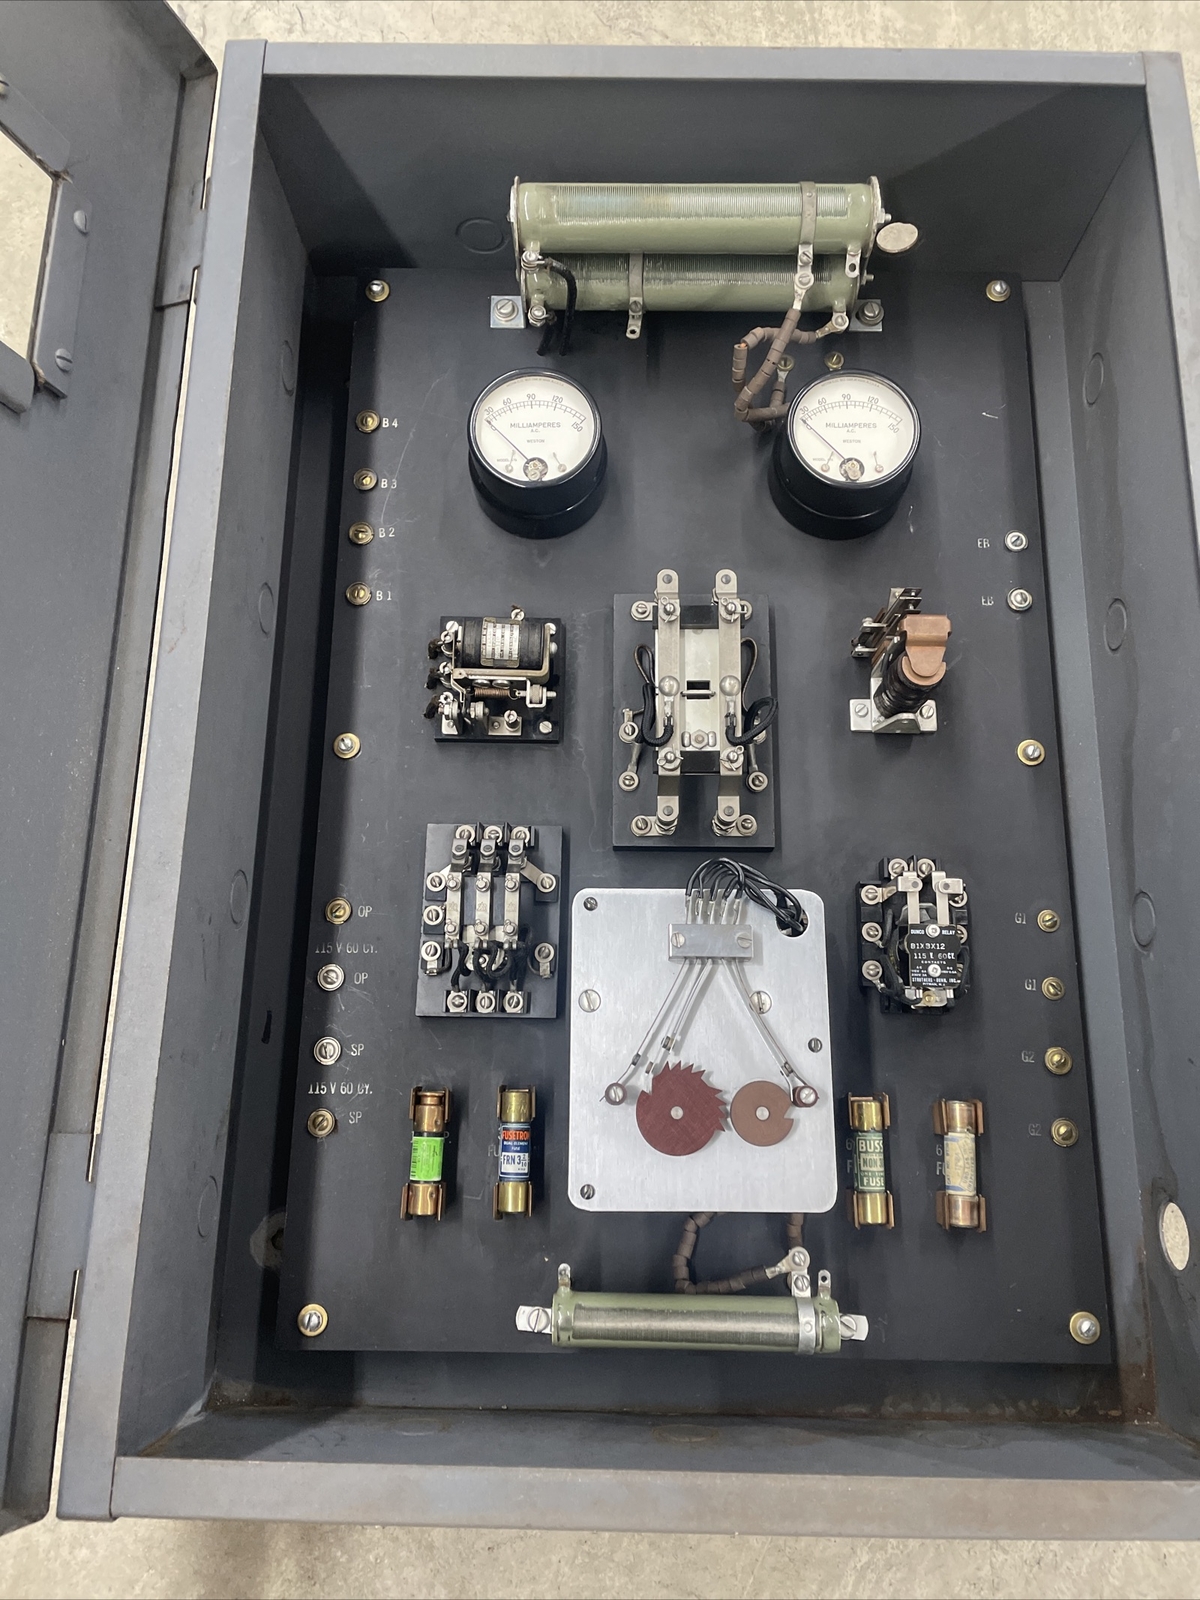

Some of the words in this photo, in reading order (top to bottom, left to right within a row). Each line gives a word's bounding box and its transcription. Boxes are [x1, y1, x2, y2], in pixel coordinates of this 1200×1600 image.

[503, 398, 512, 406] 60
[552, 395, 563, 403] 120
[868, 396, 879, 404] 120
[484, 407, 494, 415] 30
[799, 406, 809, 415] 30
[571, 422, 583, 432] 150
[888, 423, 899, 434] 150
[358, 906, 372, 917] OP
[315, 942, 332, 953] 115
[336, 942, 342, 953] V
[347, 942, 358, 953] 60
[354, 972, 368, 984] OP
[351, 1043, 364, 1056] SP
[1022, 1050, 1034, 1062] G2
[308, 1082, 327, 1094] 115
[330, 1082, 336, 1094] V
[340, 1082, 353, 1094] 60
[358, 1083, 372, 1094] CY.
[349, 1111, 362, 1124] SP
[1028, 1124, 1041, 1136] G2
[936, 1144, 942, 1156] 6
[503, 1155, 515, 1165] FRN
